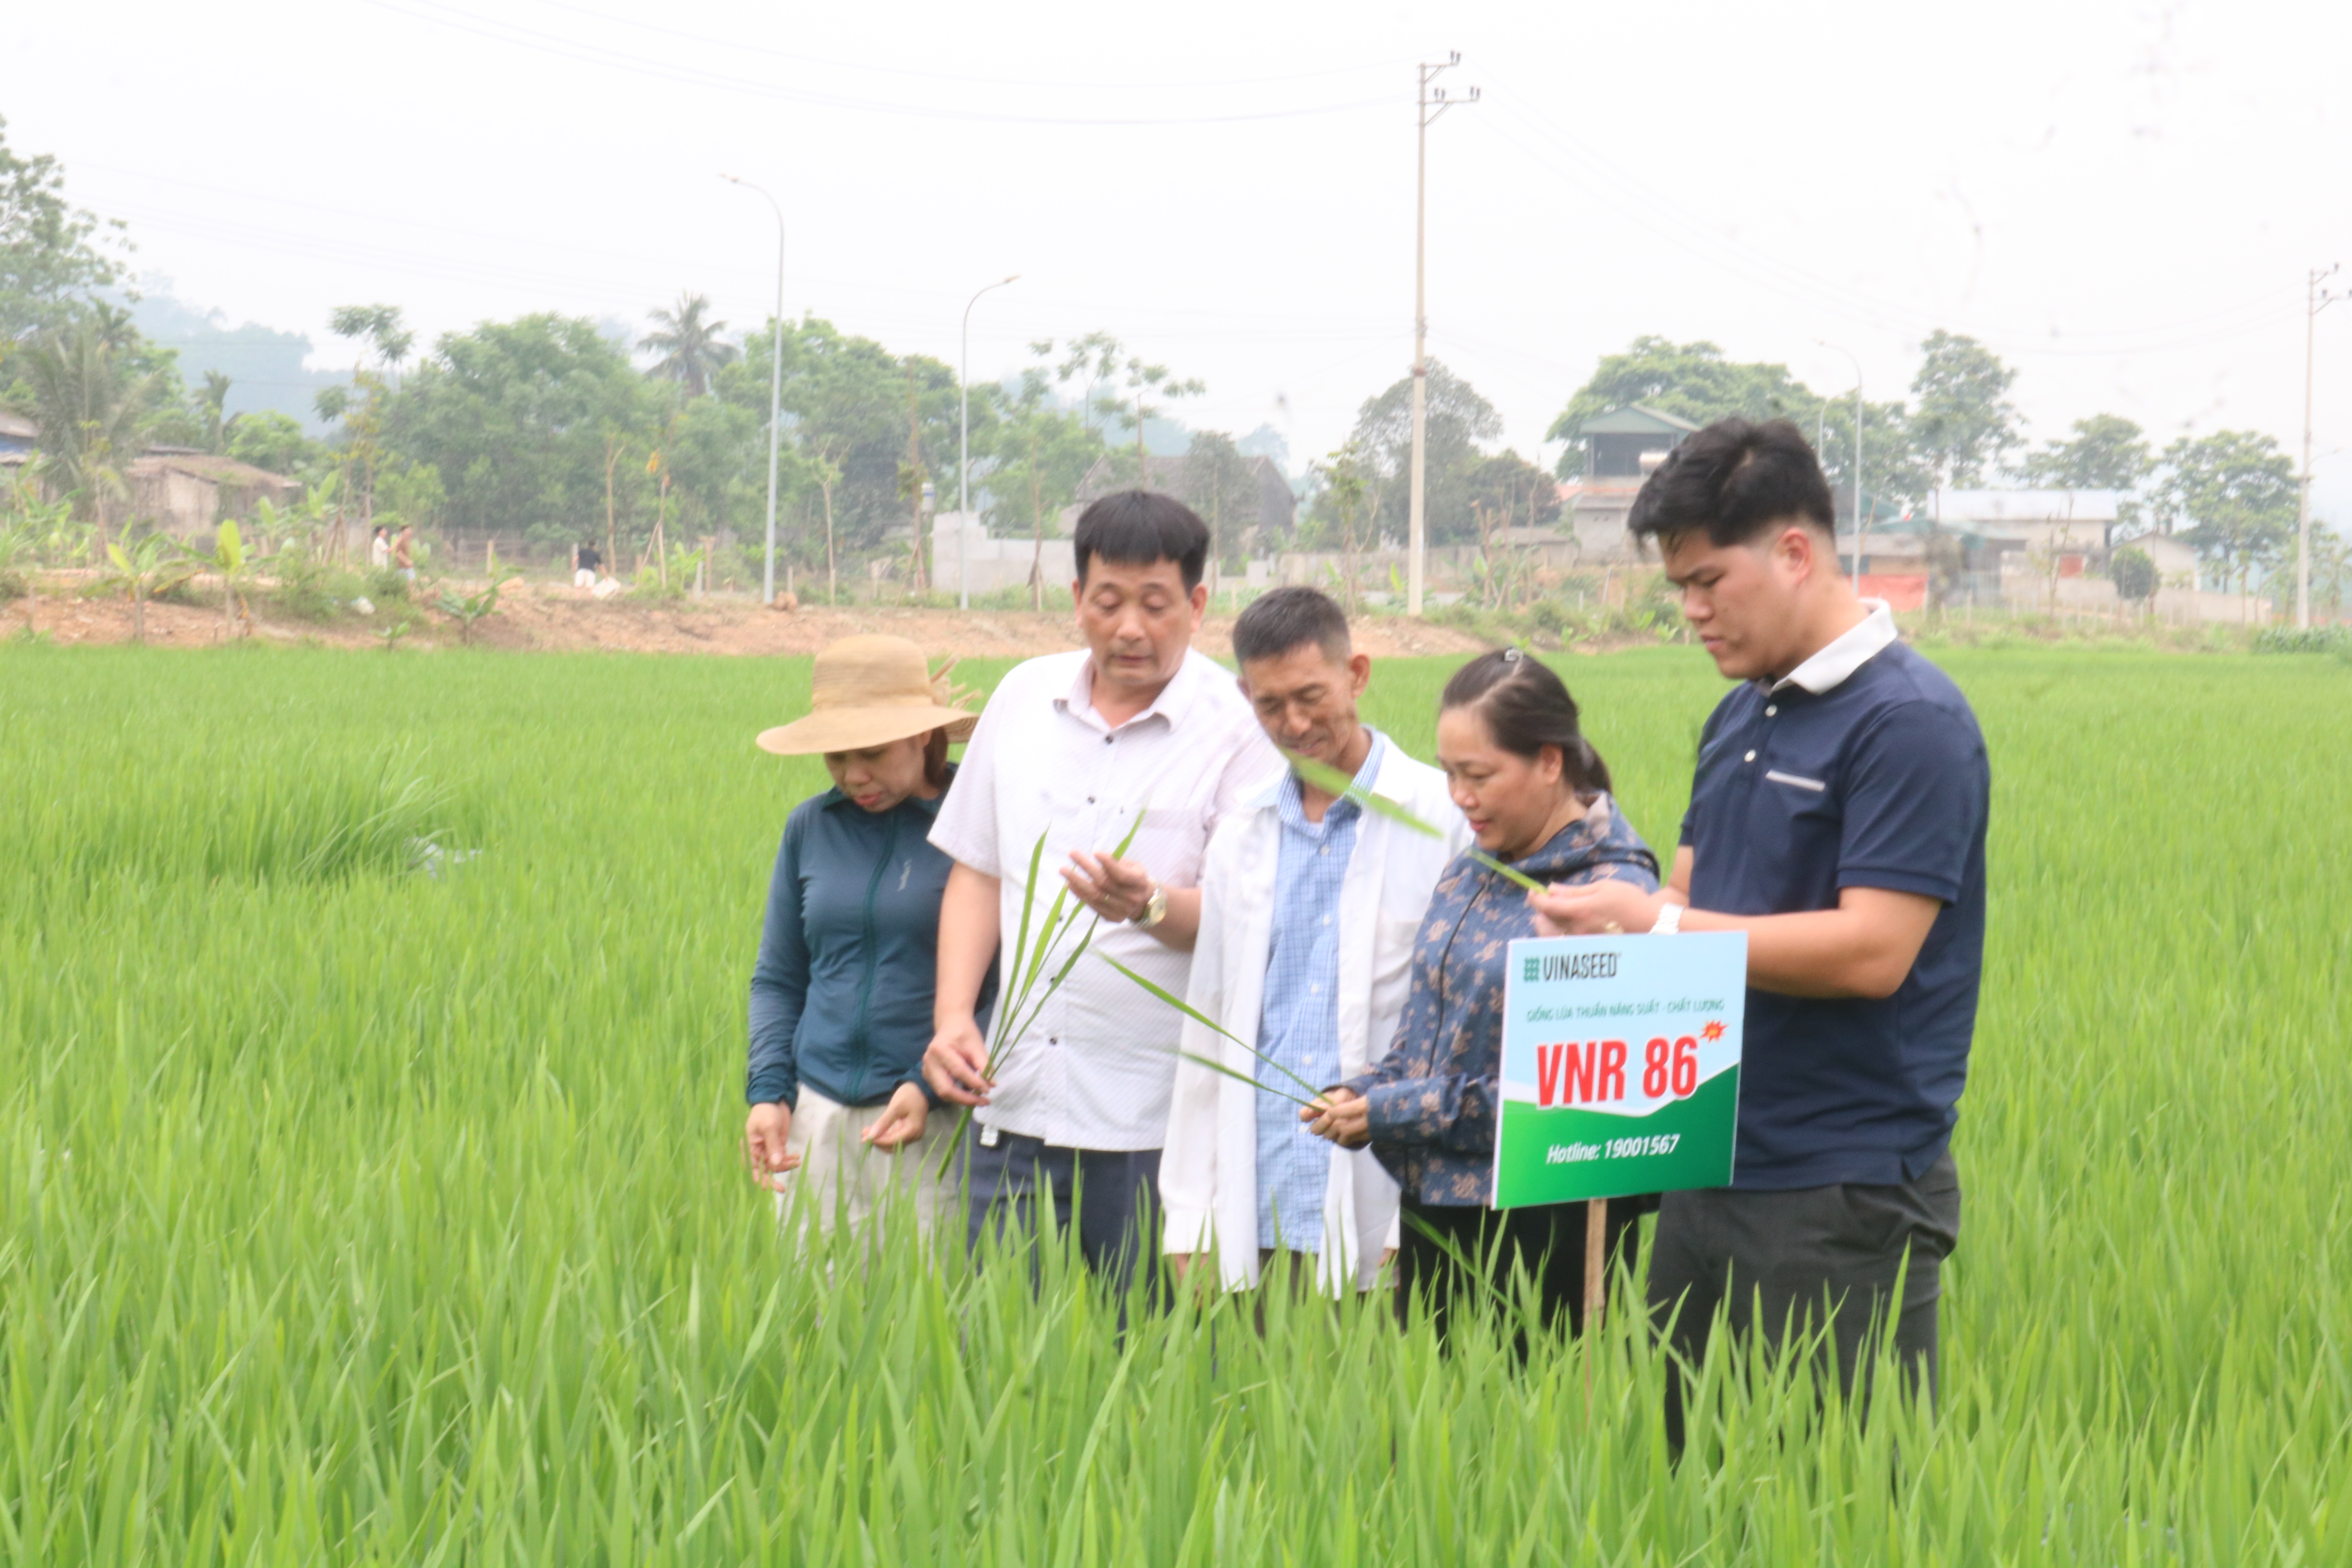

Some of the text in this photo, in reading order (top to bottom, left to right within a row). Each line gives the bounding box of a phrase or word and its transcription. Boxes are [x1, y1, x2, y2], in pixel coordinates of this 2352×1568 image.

[1537, 1036, 1698, 1106] VNR 86
[1546, 1134, 1680, 1164] Hotline: 19001567
